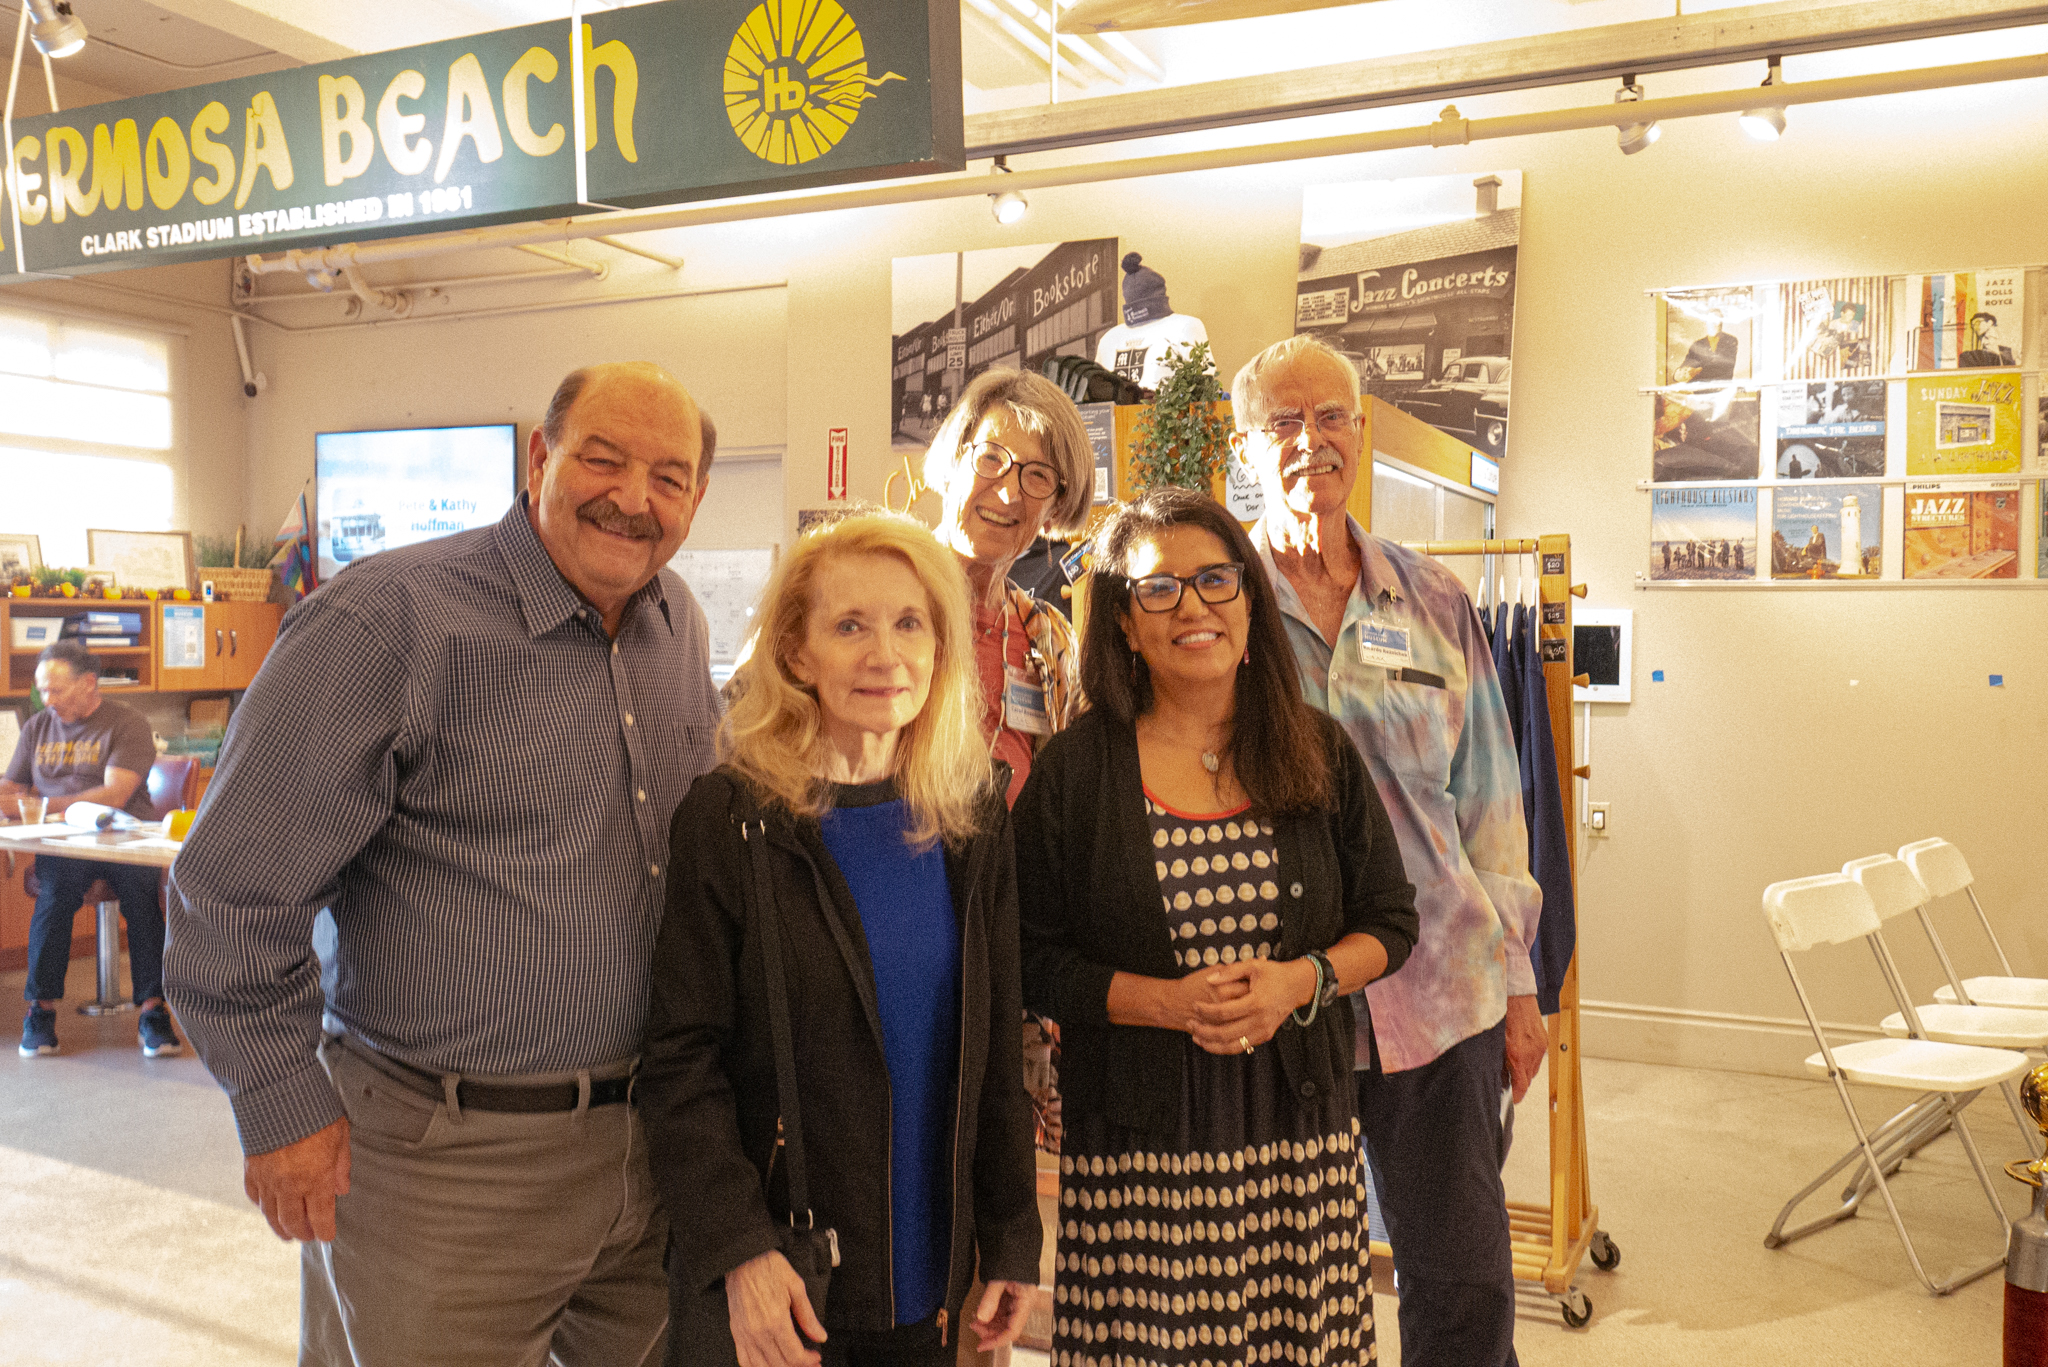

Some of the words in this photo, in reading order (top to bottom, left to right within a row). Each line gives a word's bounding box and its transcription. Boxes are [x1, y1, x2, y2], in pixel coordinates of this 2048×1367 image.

[0, 91, 294, 250] ERMOSA
[81, 229, 143, 257] CLARK
[146, 215, 234, 249] STADIUM
[238, 197, 384, 237] ESTABLISHED
[388, 192, 414, 219] IN
[1033, 253, 1099, 317] Bookstore
[1350, 270, 1397, 313] Jazz
[1402, 266, 1510, 299] Concerts
[973, 297, 1015, 338] Either/Or
[949, 357, 963, 367] 25
[1921, 387, 1968, 401] SUNDAY
[1829, 426, 1846, 435] THE
[1848, 425, 1877, 433] BLUES
[1655, 489, 1708, 504] LIGHTHOUSE
[399, 500, 425, 511] Pete
[429, 499, 438, 511] &
[441, 499, 477, 514] Kathy
[1910, 498, 1965, 515] JAZZ
[411, 518, 465, 531] Hoffman
